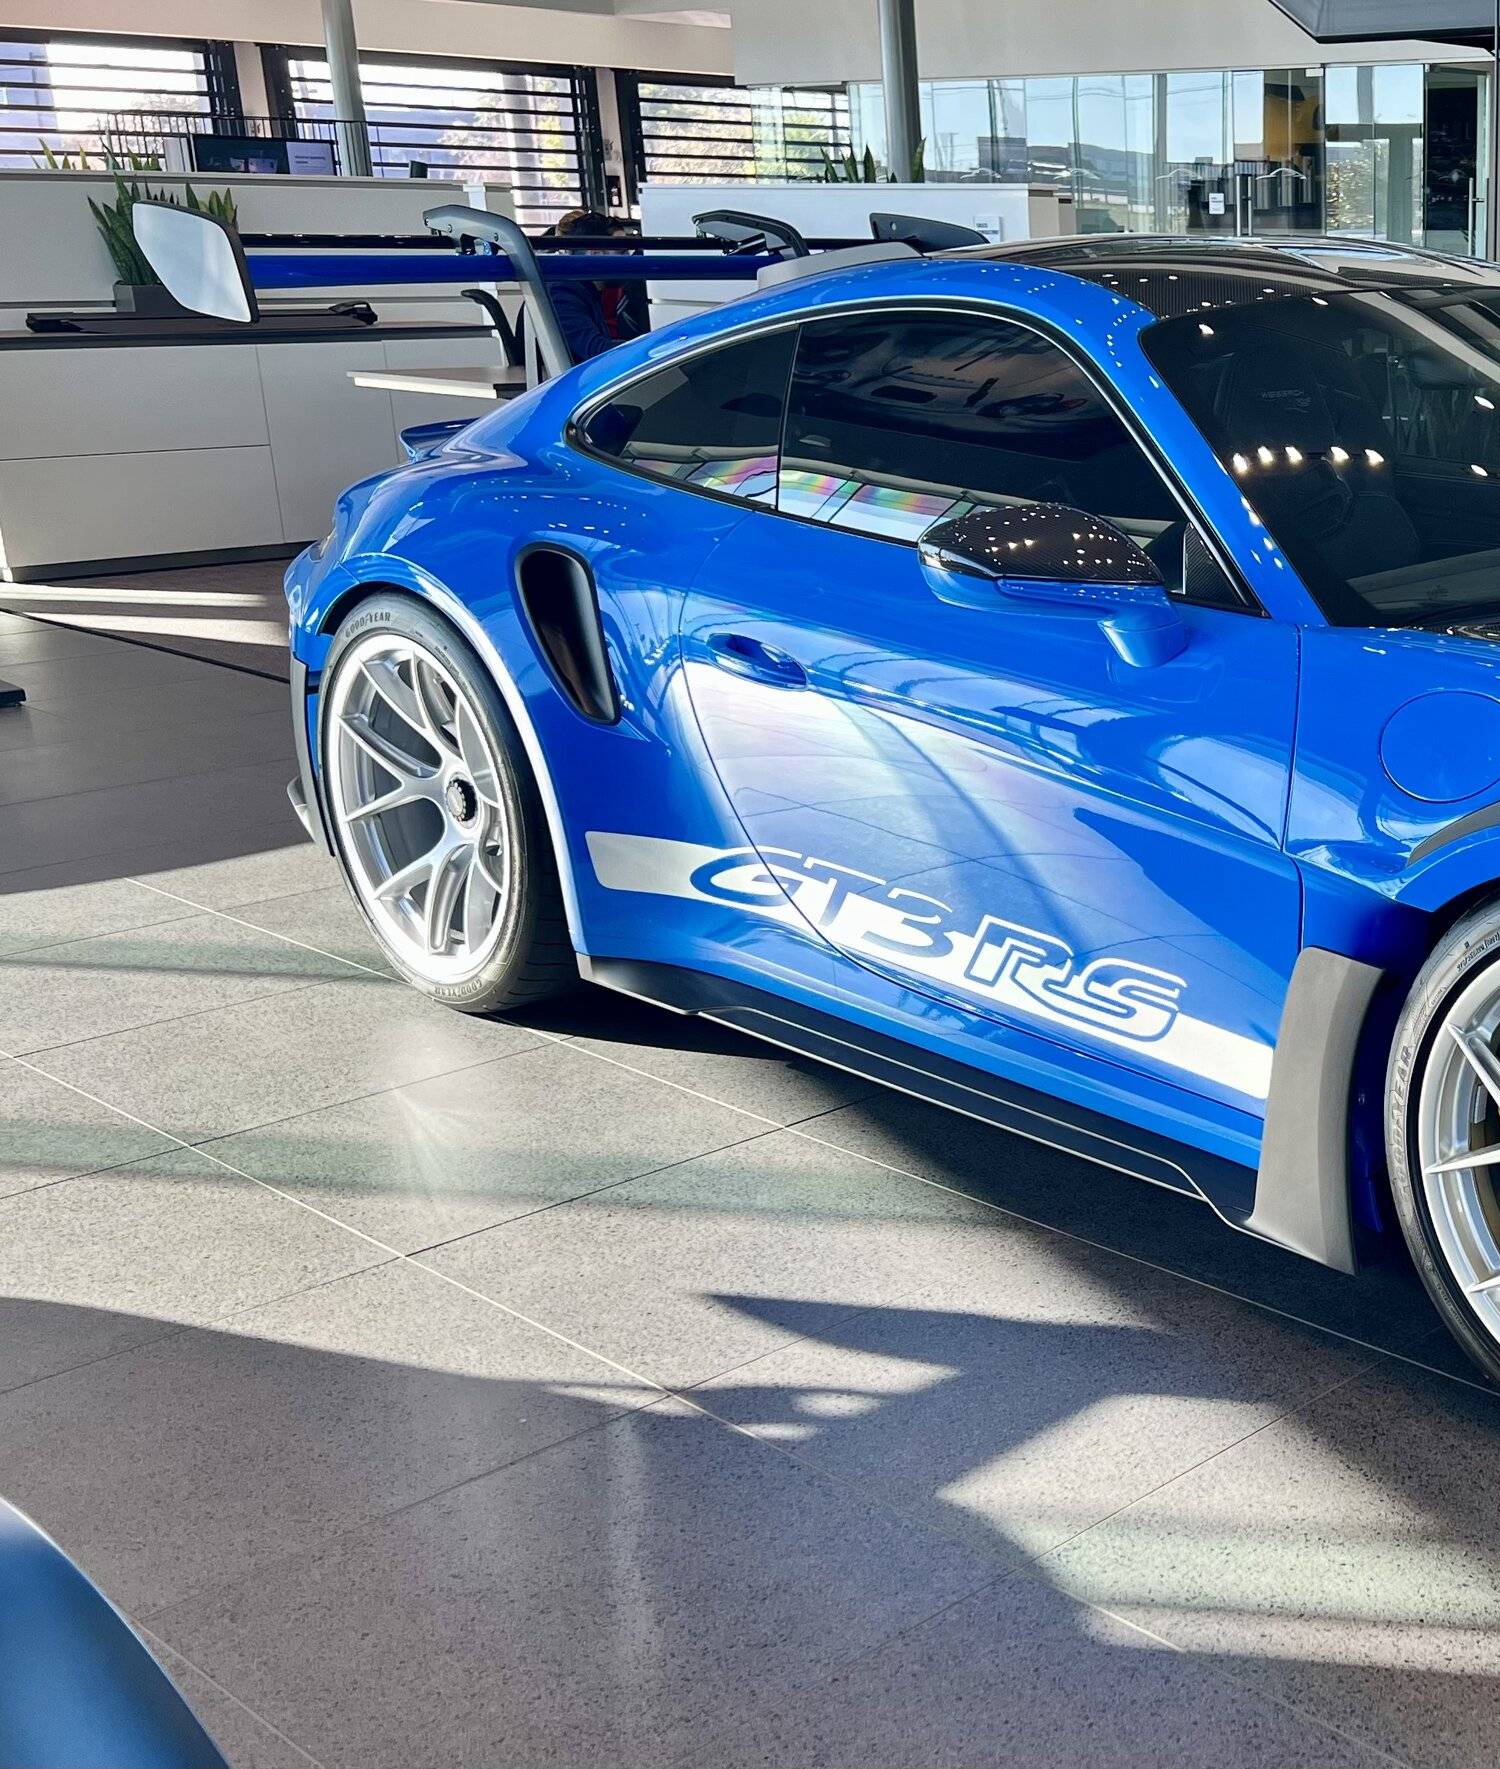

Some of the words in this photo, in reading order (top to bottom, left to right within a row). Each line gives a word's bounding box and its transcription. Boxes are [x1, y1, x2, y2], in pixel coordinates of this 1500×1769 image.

[345, 611, 391, 638] GOODYEAR
[690, 847, 954, 958] GT3
[963, 914, 1188, 1042] RS
[1391, 1045, 1412, 1198] GOODYEAR
